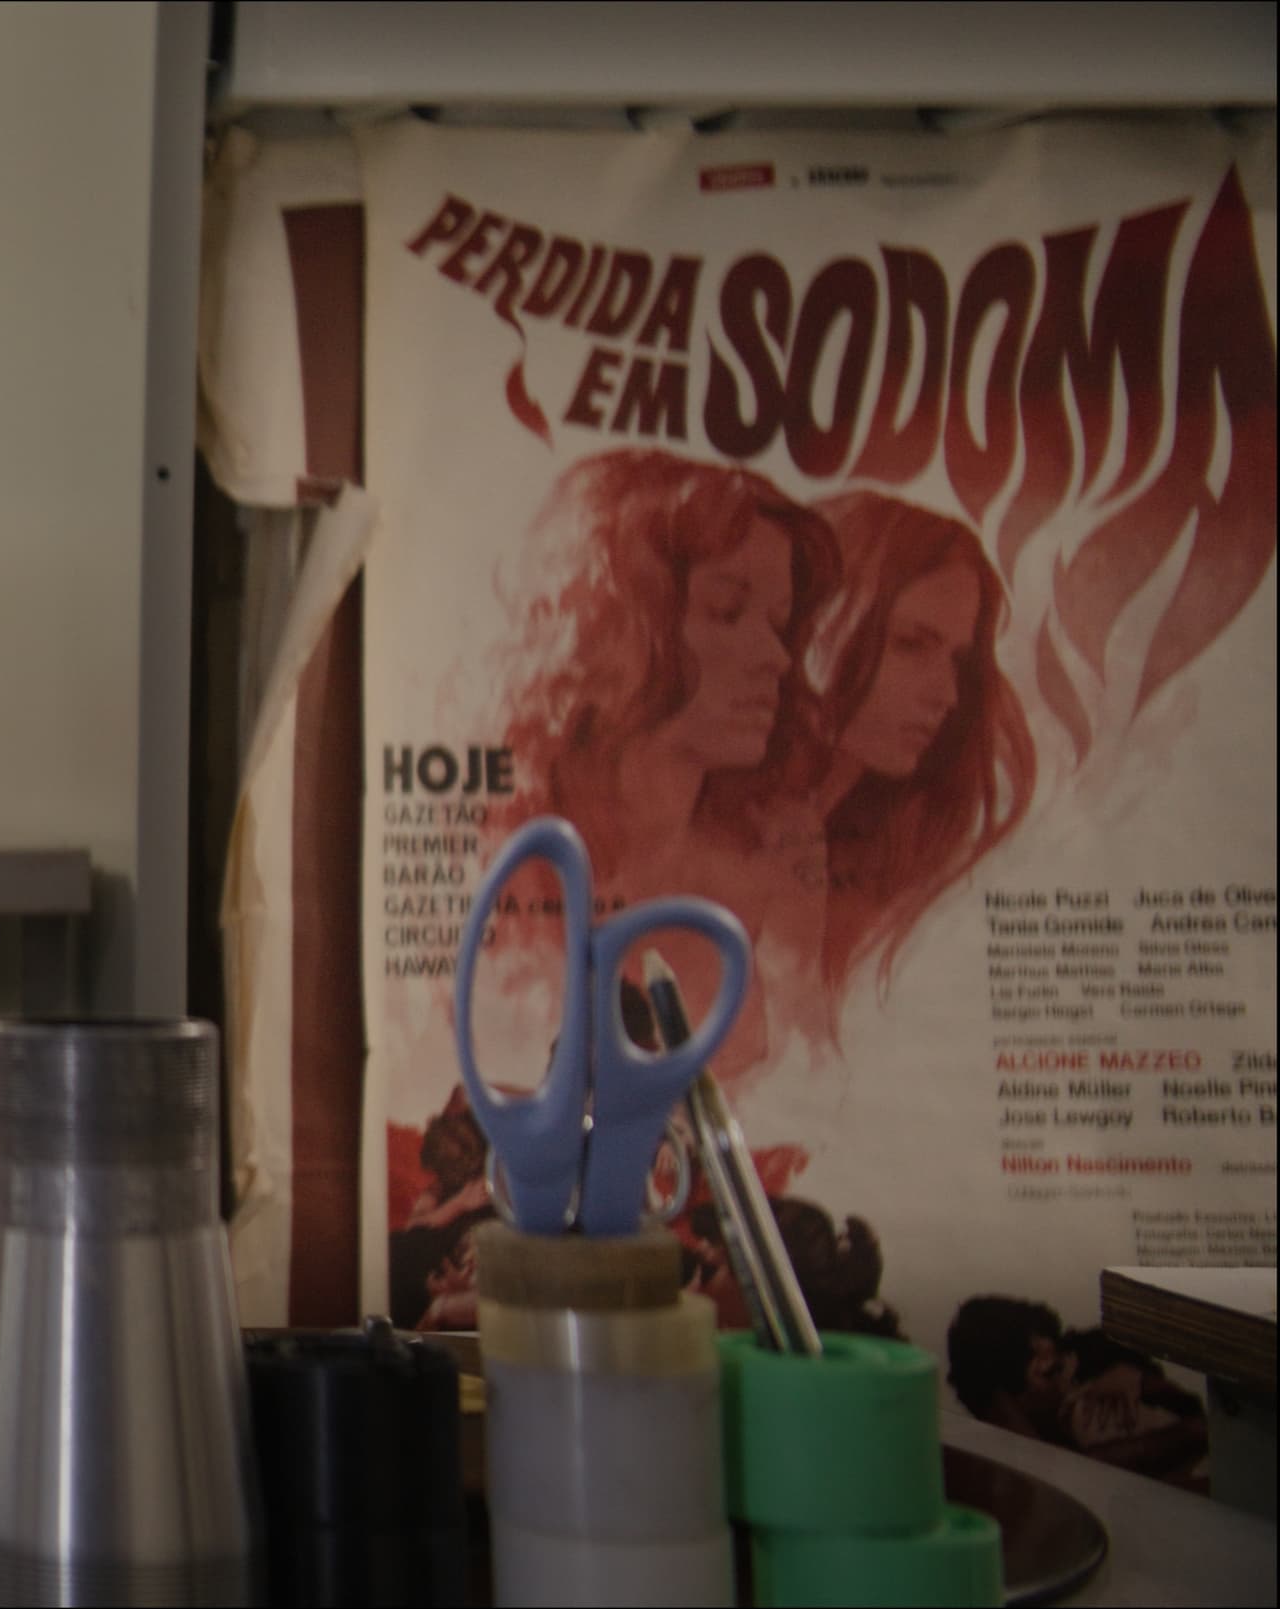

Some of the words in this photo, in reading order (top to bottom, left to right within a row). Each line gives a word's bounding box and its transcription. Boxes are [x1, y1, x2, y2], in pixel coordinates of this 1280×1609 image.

[407, 194, 702, 353] PERDIDA
[702, 160, 1278, 600] SODOMA
[561, 346, 690, 442] EM
[383, 746, 514, 795] HOJE
[383, 834, 478, 854] PREMIER
[383, 862, 466, 886] BARÃO
[985, 888, 1048, 908] Nicole
[1134, 886, 1183, 907] Juca
[1190, 887, 1216, 906] de
[1044, 915, 1124, 936] Gomide
[1151, 913, 1227, 933] Andrea
[996, 1051, 1090, 1073] ALCIONE
[1100, 1050, 1202, 1072] MAZZEO
[998, 1079, 1060, 1098] Aldine
[1068, 1077, 1131, 1098] Müller
[1053, 1107, 1134, 1129] Lewgoy
[1162, 1106, 1252, 1126] Roberto
[1001, 1154, 1060, 1175] Nilton
[1067, 1153, 1192, 1175] Nascimento
